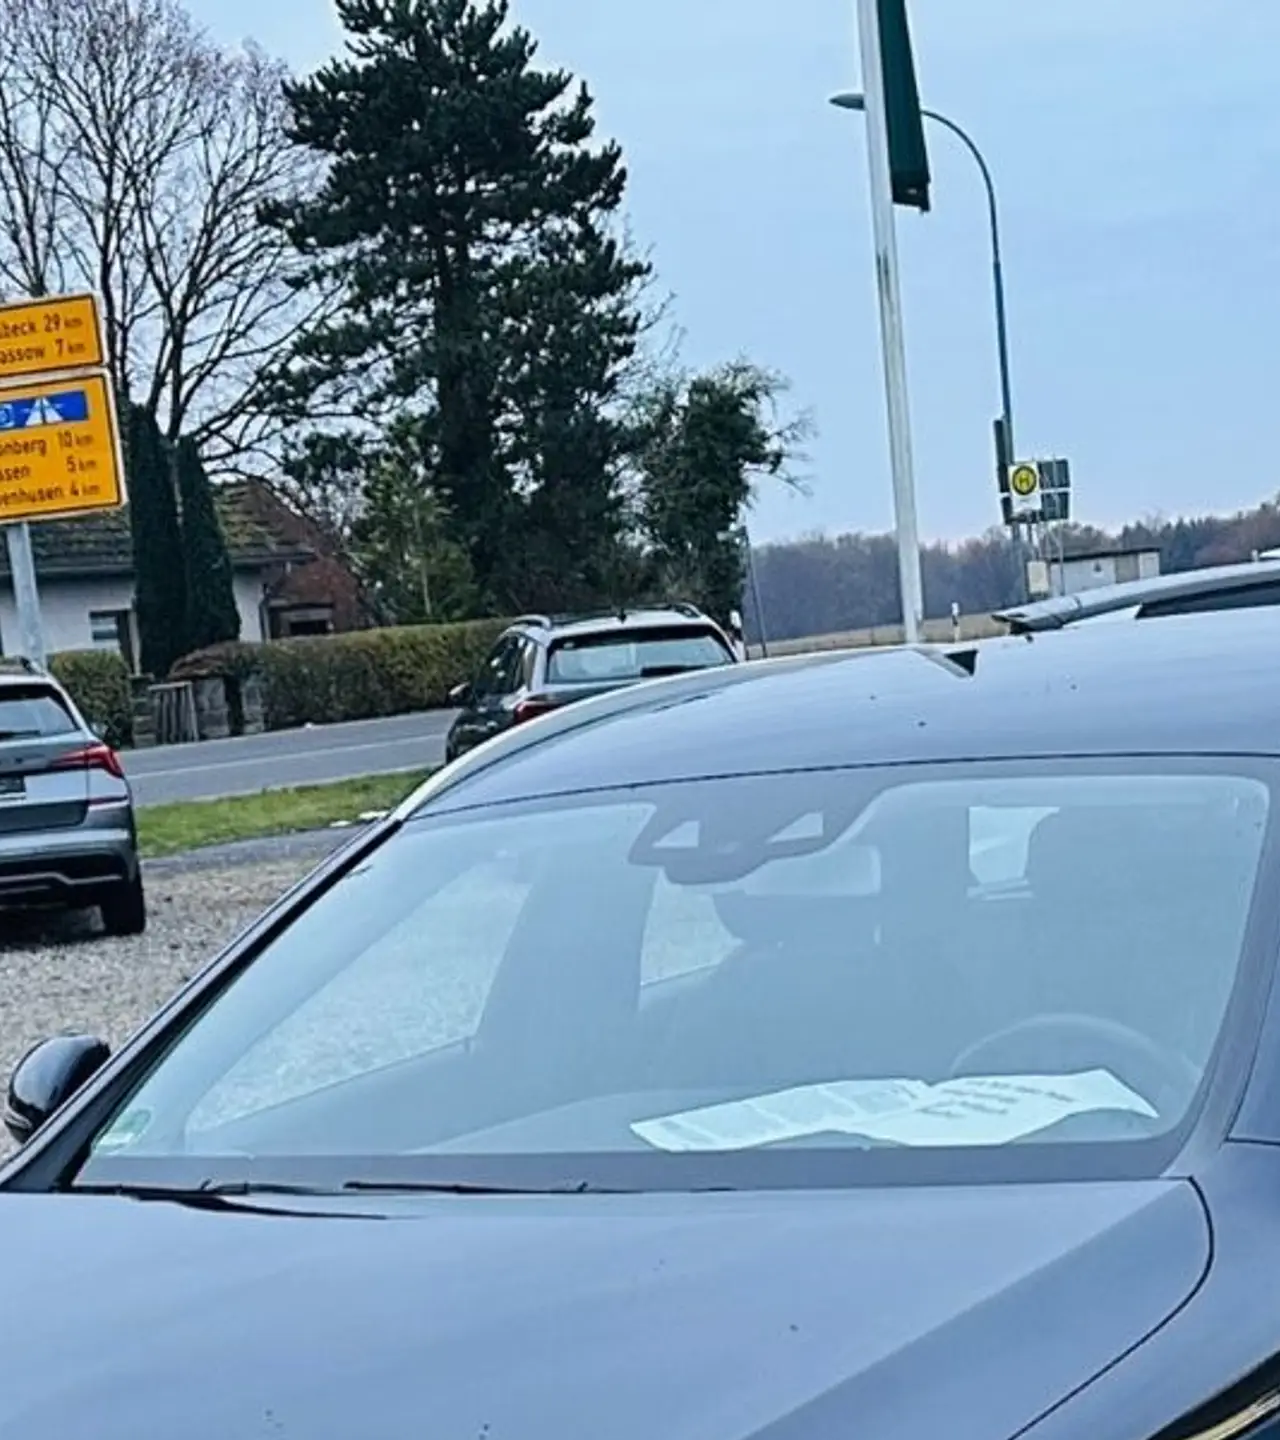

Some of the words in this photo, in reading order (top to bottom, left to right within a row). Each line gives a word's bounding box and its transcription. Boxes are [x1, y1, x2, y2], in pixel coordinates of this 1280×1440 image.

[42, 313, 61, 334] 29
[54, 338, 64, 358] 7
[65, 455, 77, 474] 5
[70, 480, 80, 497] 4
